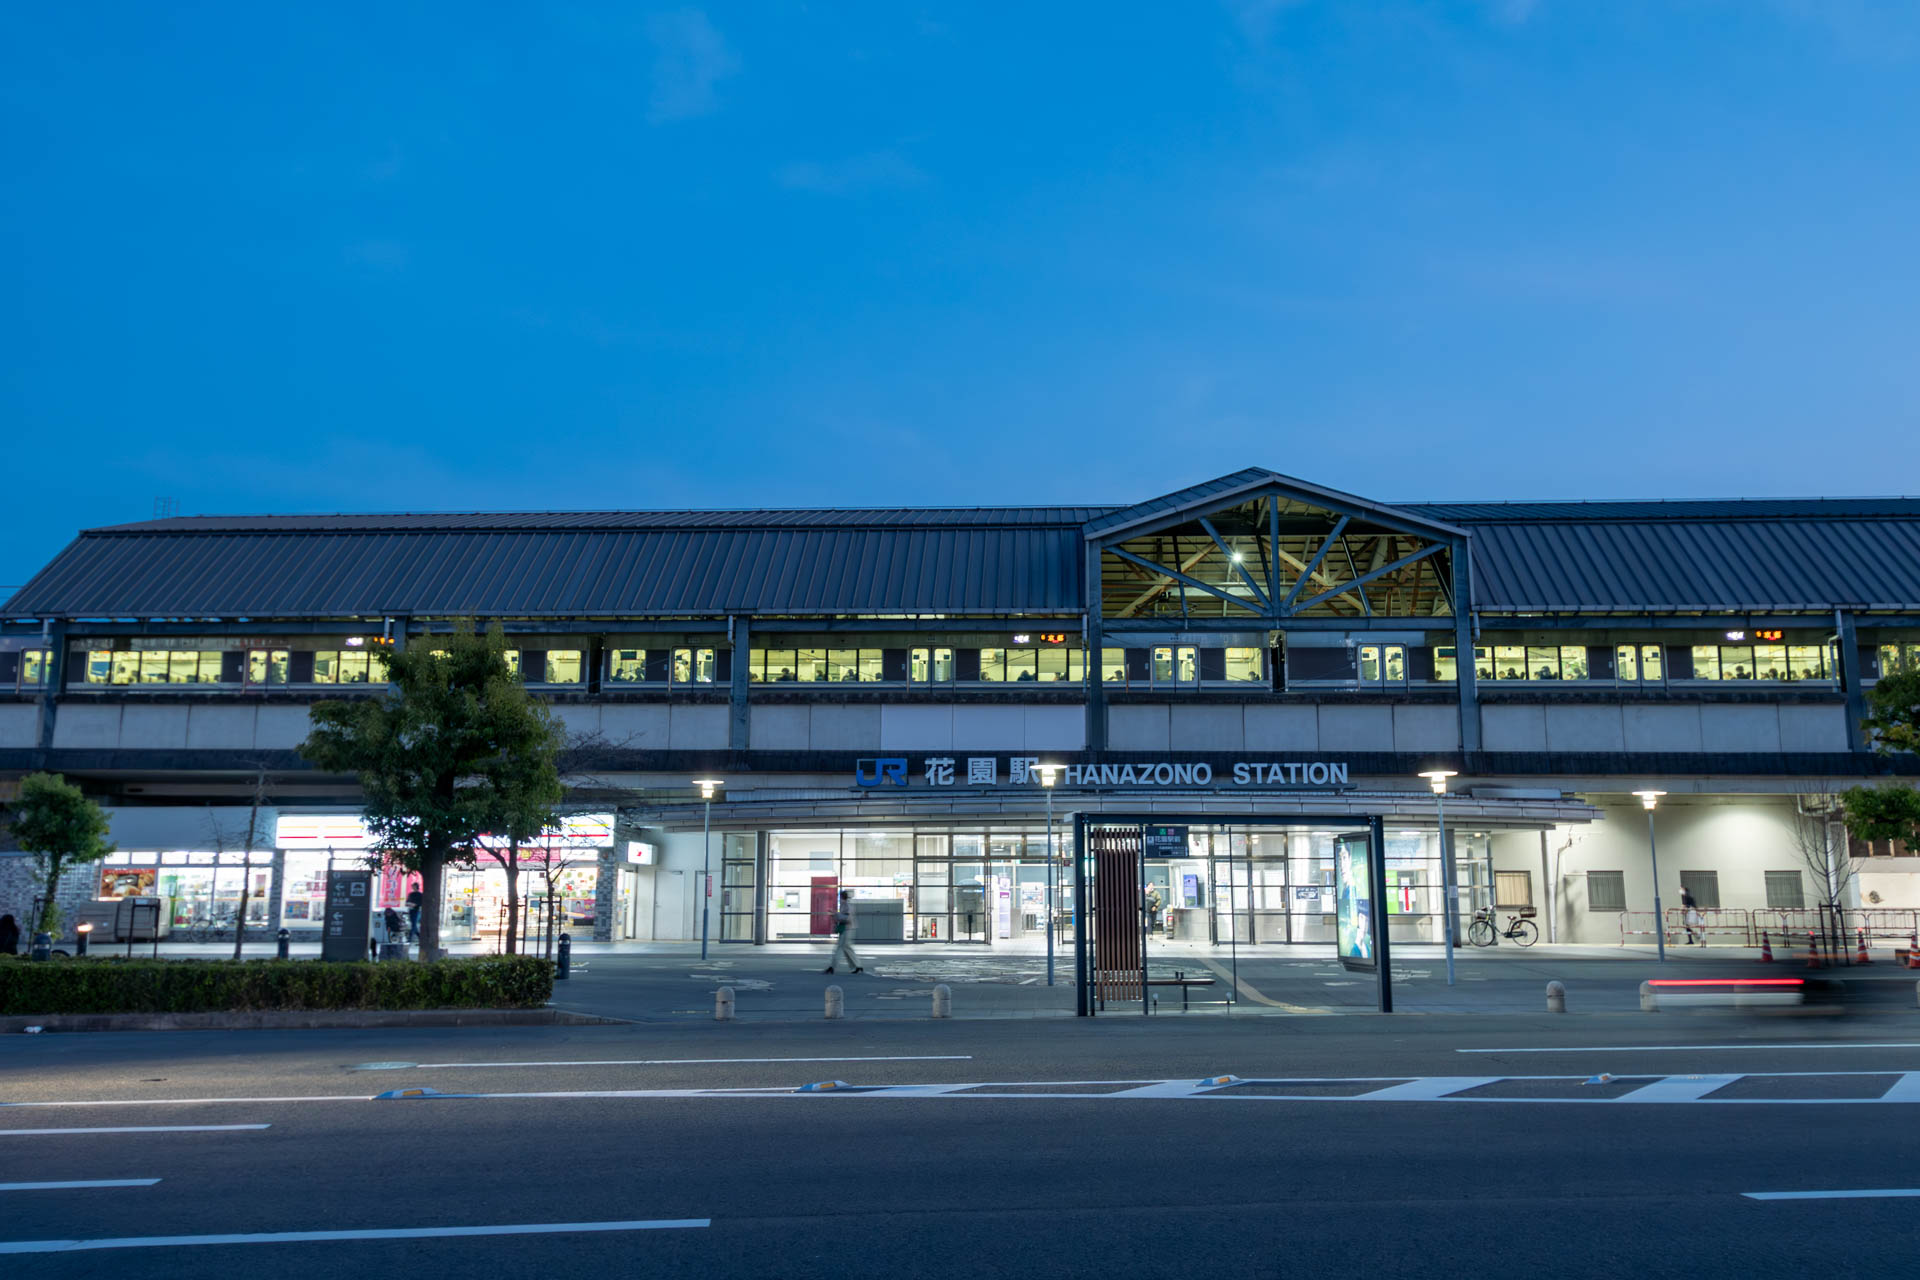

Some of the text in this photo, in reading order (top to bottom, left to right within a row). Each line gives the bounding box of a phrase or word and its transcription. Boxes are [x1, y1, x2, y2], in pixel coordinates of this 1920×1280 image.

[857, 757, 1348, 786] JR 花園駅 HANAZONO STATION
